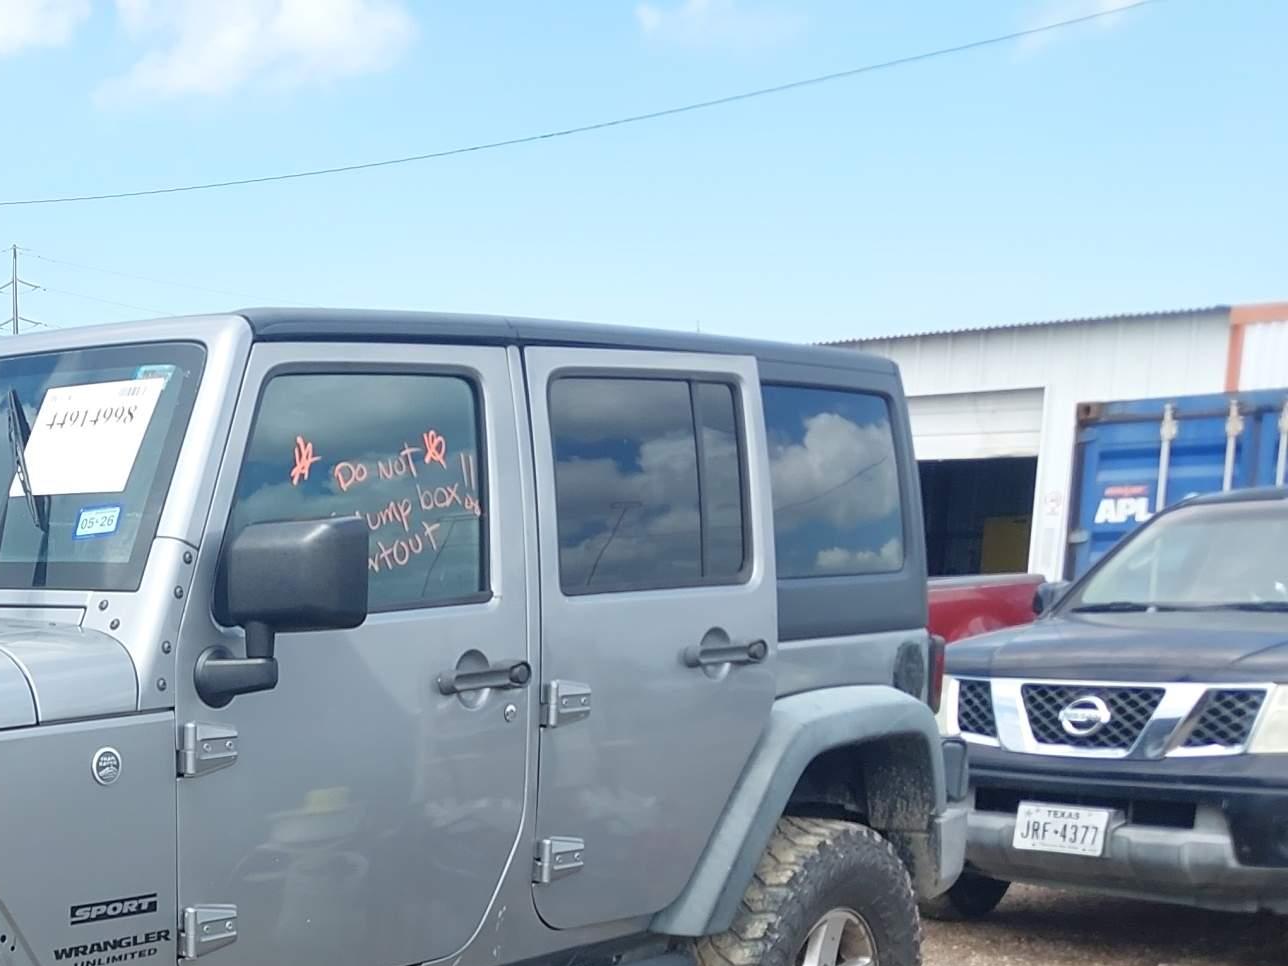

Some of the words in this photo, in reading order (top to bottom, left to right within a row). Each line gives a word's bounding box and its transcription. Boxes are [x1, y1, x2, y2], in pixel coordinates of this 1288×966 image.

[46, 405, 137, 429] 44914998
[355, 498, 412, 533] ump
[1094, 496, 1154, 523] APL
[1047, 810, 1081, 820] TEXAS
[72, 899, 156, 921] SPORT
[54, 929, 171, 960] WRANGLER
